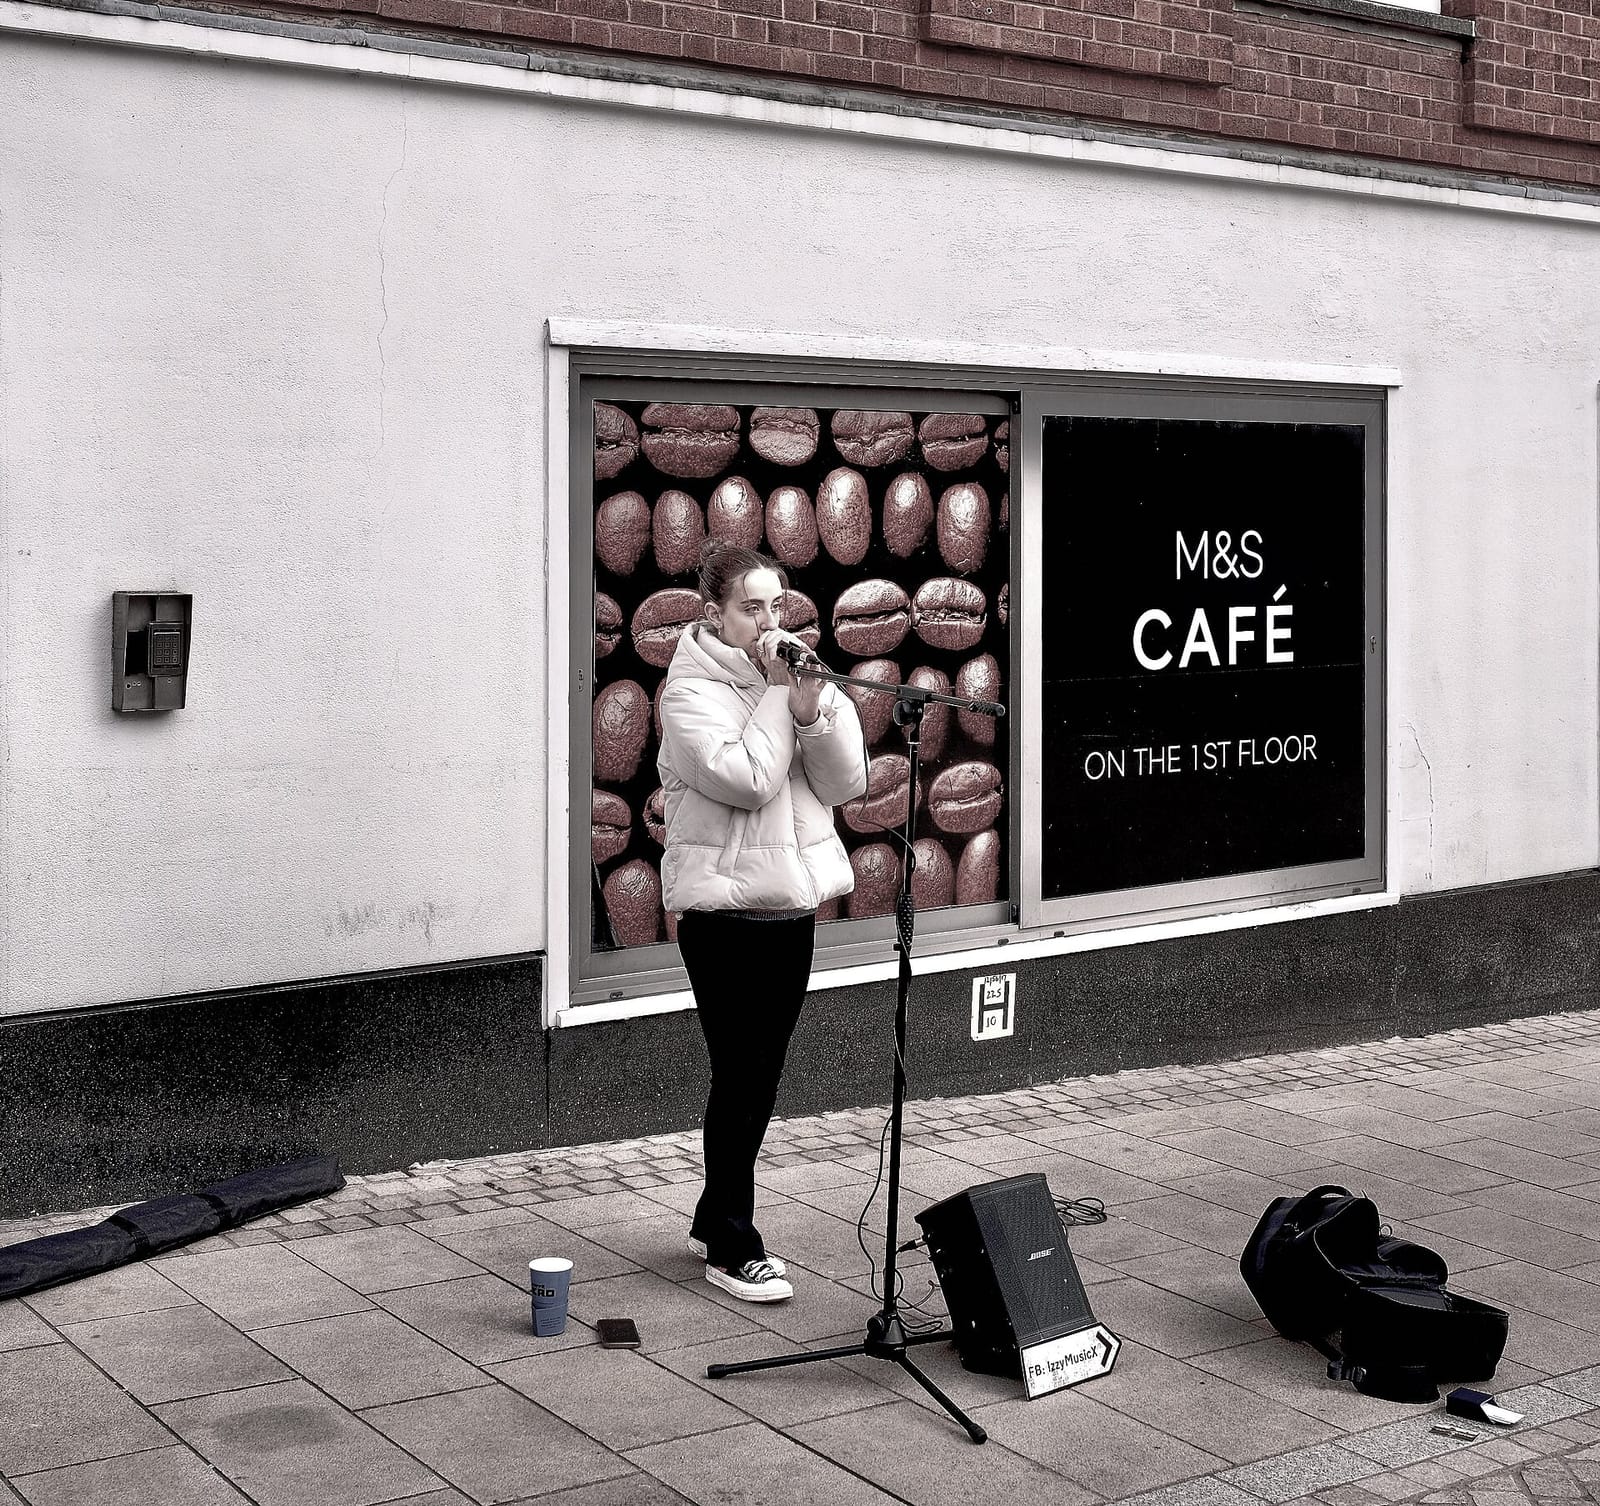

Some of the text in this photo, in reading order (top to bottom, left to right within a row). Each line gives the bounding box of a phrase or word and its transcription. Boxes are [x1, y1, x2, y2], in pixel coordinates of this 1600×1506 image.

[1176, 529, 1264, 580] M&S
[1132, 583, 1294, 671] CAFÉ
[1085, 735, 1317, 780] ON THE 1ST FLOOR
[986, 988, 1002, 999] 225
[986, 1015, 997, 1028] 10
[1028, 1345, 1098, 1379] FB: IzzyMusicX
